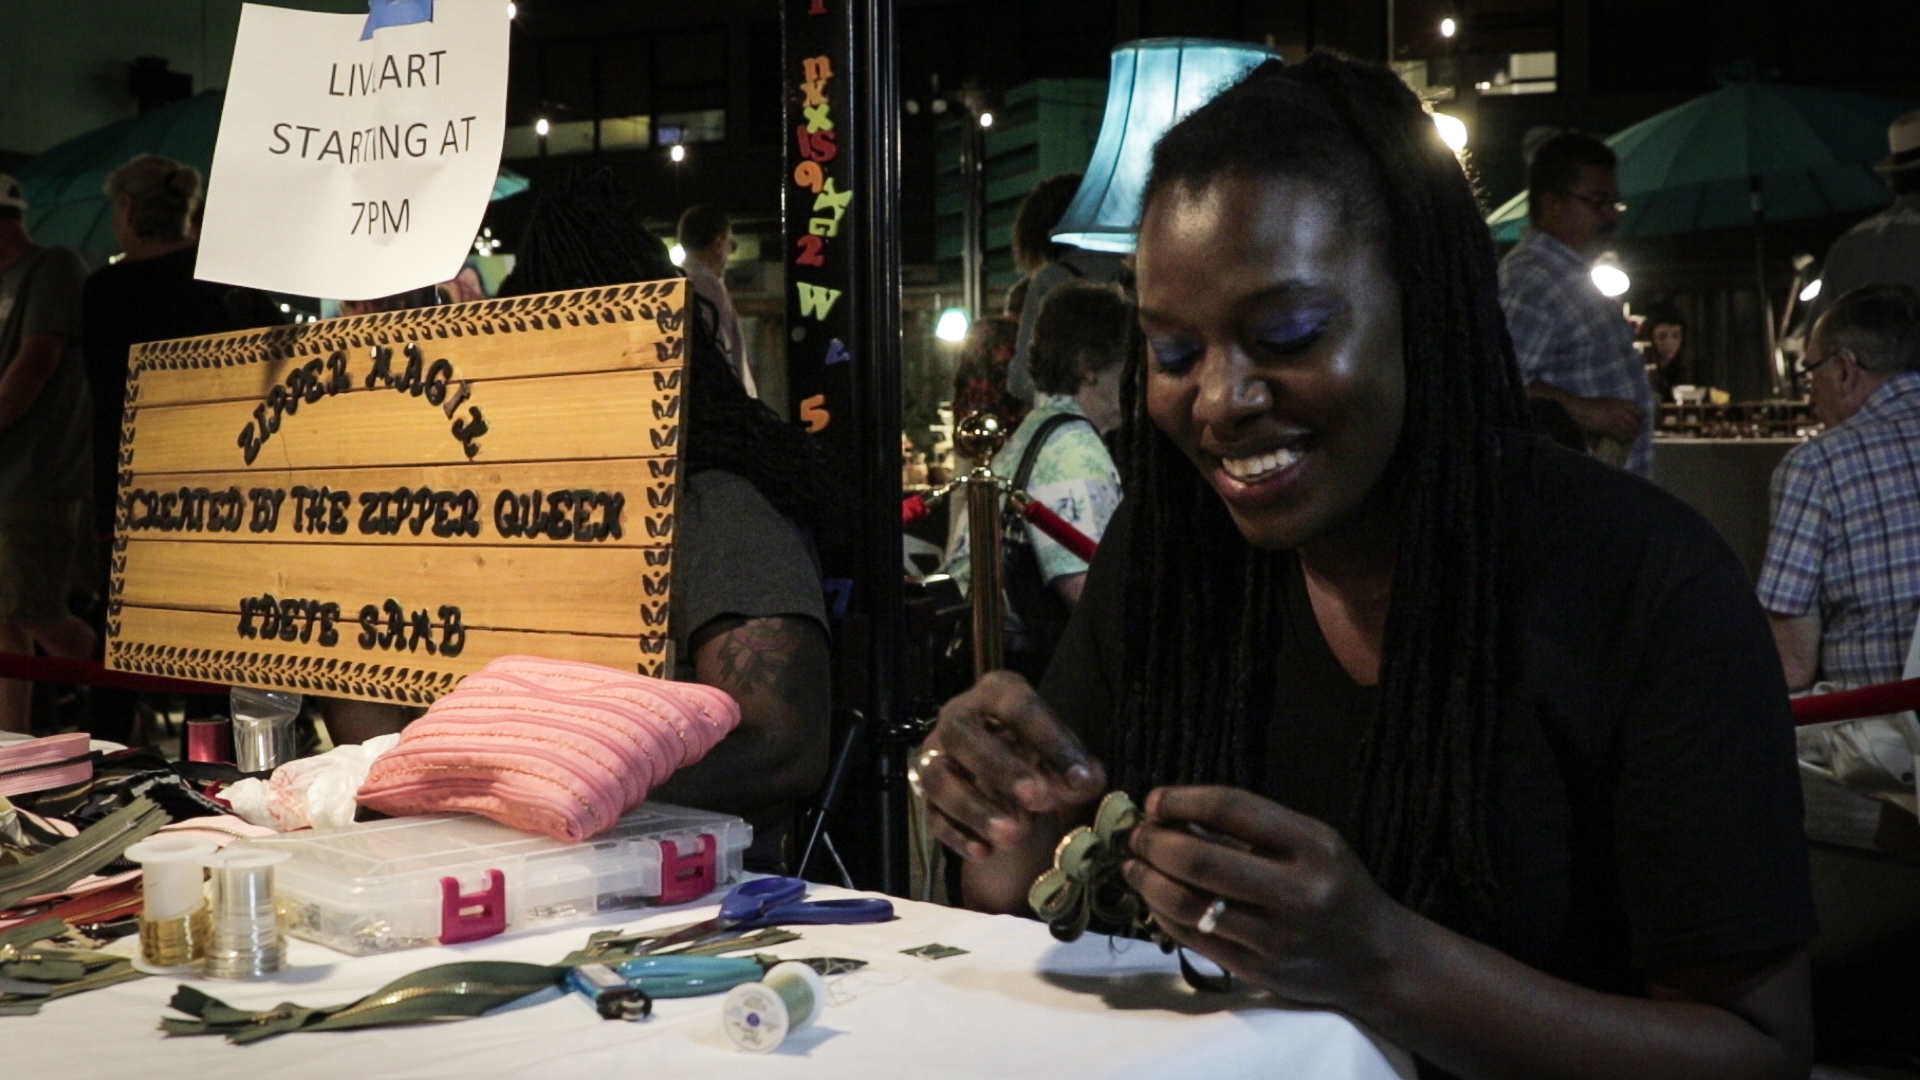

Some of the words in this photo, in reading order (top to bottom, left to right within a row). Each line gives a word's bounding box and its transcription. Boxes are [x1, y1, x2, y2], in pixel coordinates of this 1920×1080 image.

[328, 62, 377, 97] LIV
[379, 49, 447, 89] ART
[268, 122, 429, 165] STARTING
[439, 115, 477, 156] AT
[350, 198, 411, 236] 7PM
[237, 350, 353, 467] ZIPPER
[126, 486, 246, 533] CREATED
[249, 487, 287, 534] BY
[290, 485, 352, 535] THE
[358, 485, 481, 539] ZIPPER
[494, 488, 626, 543] QUEEN
[357, 597, 467, 659] SAMB
